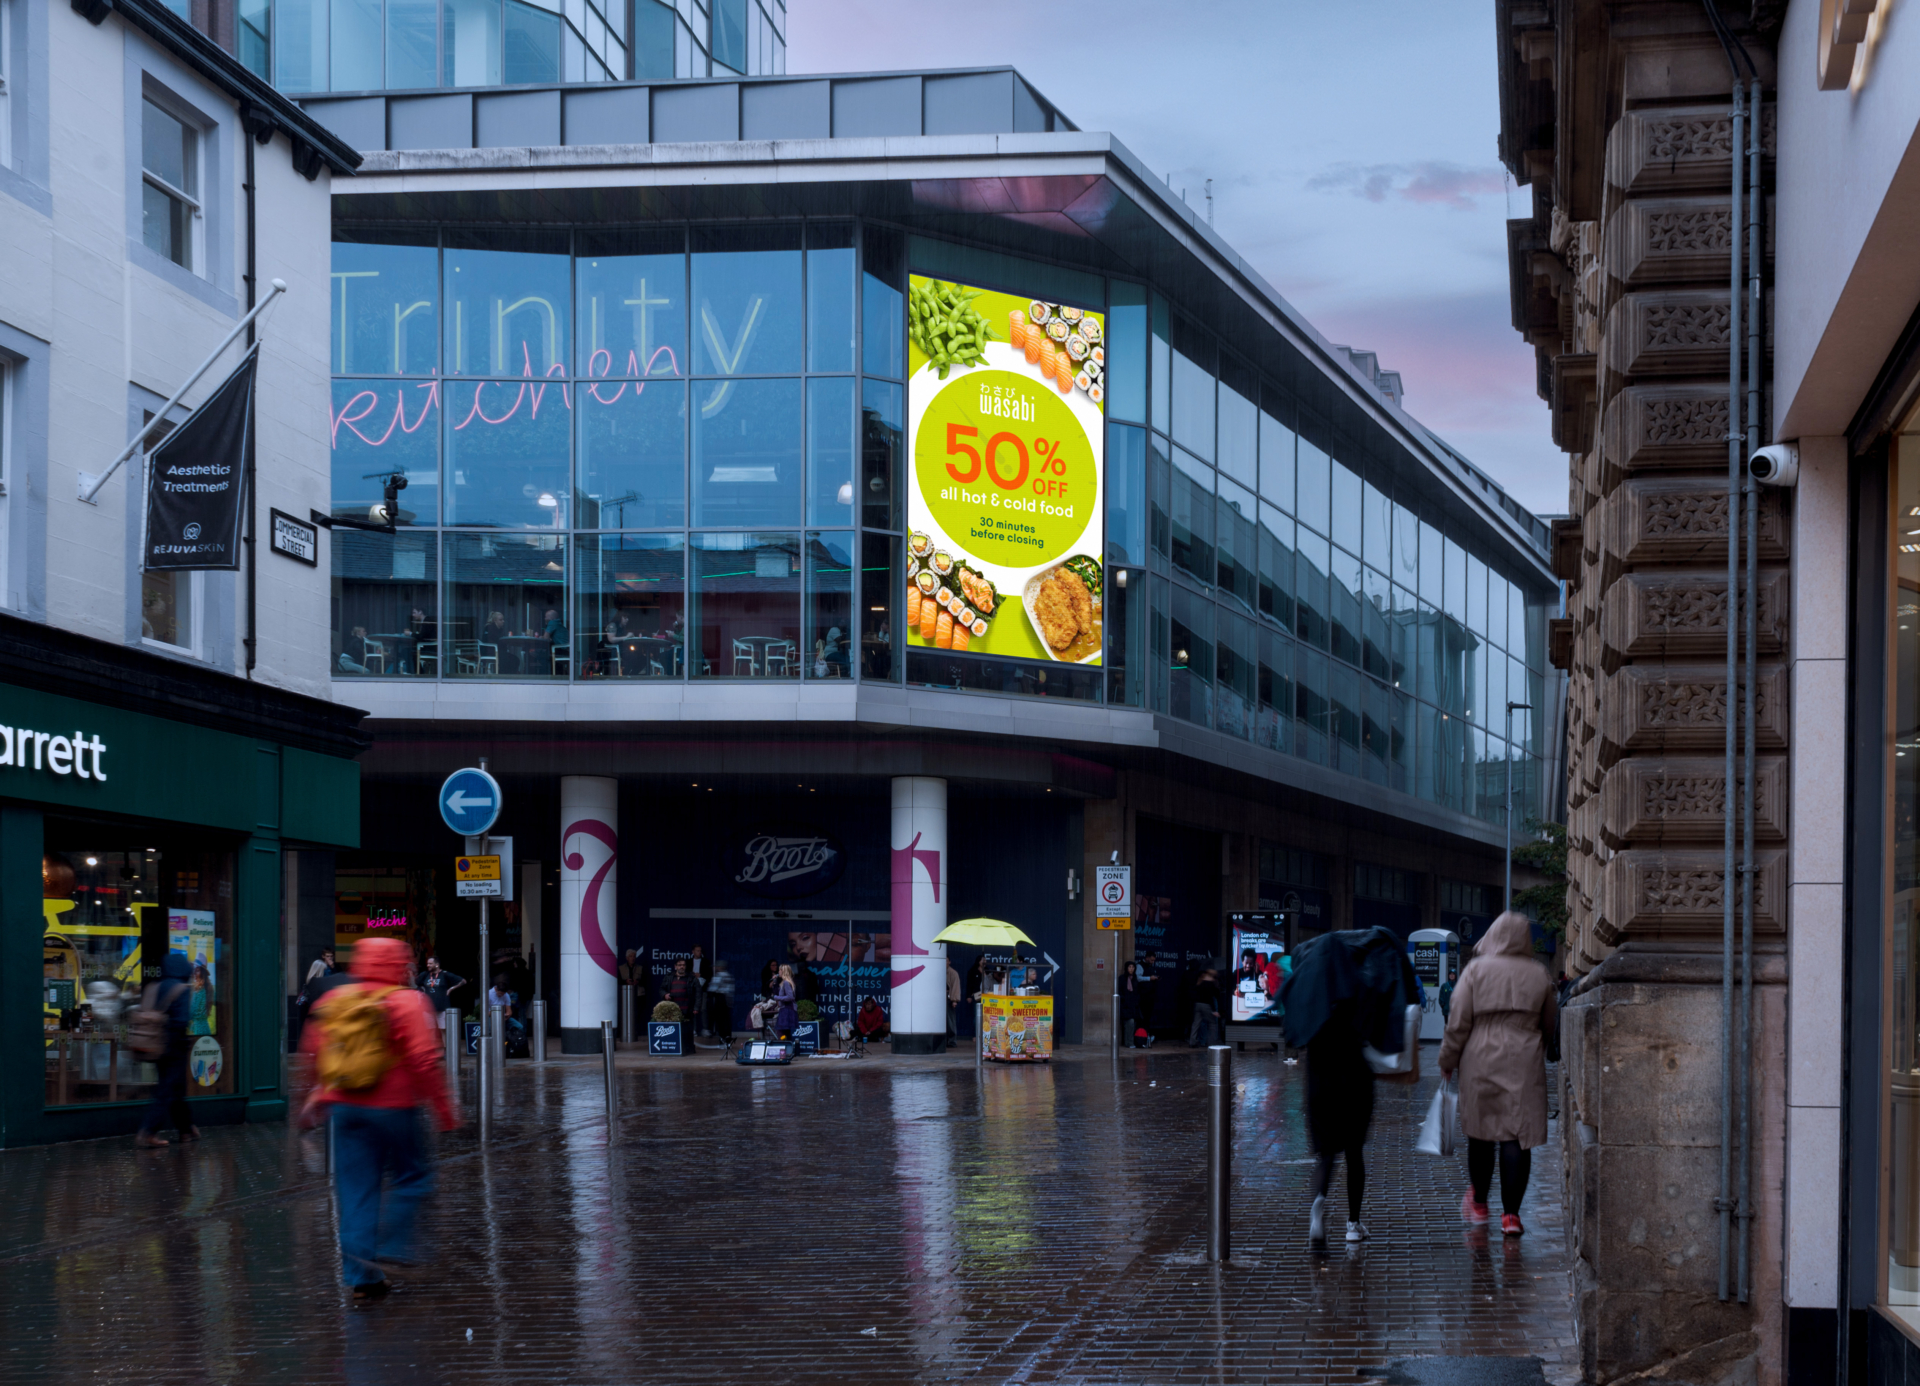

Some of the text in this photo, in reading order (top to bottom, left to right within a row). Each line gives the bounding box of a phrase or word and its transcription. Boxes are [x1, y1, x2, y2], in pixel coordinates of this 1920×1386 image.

[331, 262, 764, 413] Trinity
[331, 341, 681, 450] kitchen
[980, 383, 1016, 398] わさび
[980, 394, 1035, 422] wasabi
[945, 422, 1067, 490] 50%
[167, 463, 231, 476] Aesthetics
[163, 481, 230, 493] Treatments
[1032, 478, 1068, 498] OFF
[940, 487, 1074, 518] all hot & cold food
[275, 515, 314, 545] COMMERCIAL
[979, 517, 1036, 534] 30 minutes
[282, 535, 306, 557] STREET
[970, 527, 1044, 549] before closing
[735, 836, 829, 883] Boots
[1303, 901, 1321, 918] beauty
[189, 928, 214, 937] allergies
[344, 925, 358, 933] Lift
[1415, 948, 1439, 958] cash
[1155, 961, 1177, 969] NOVEMBER
[816, 993, 851, 1003] ITING
[983, 1006, 1004, 1016] SWEETCORN
[1012, 1008, 1048, 1016] SWEETCORN
[654, 1025, 676, 1037] Boots
